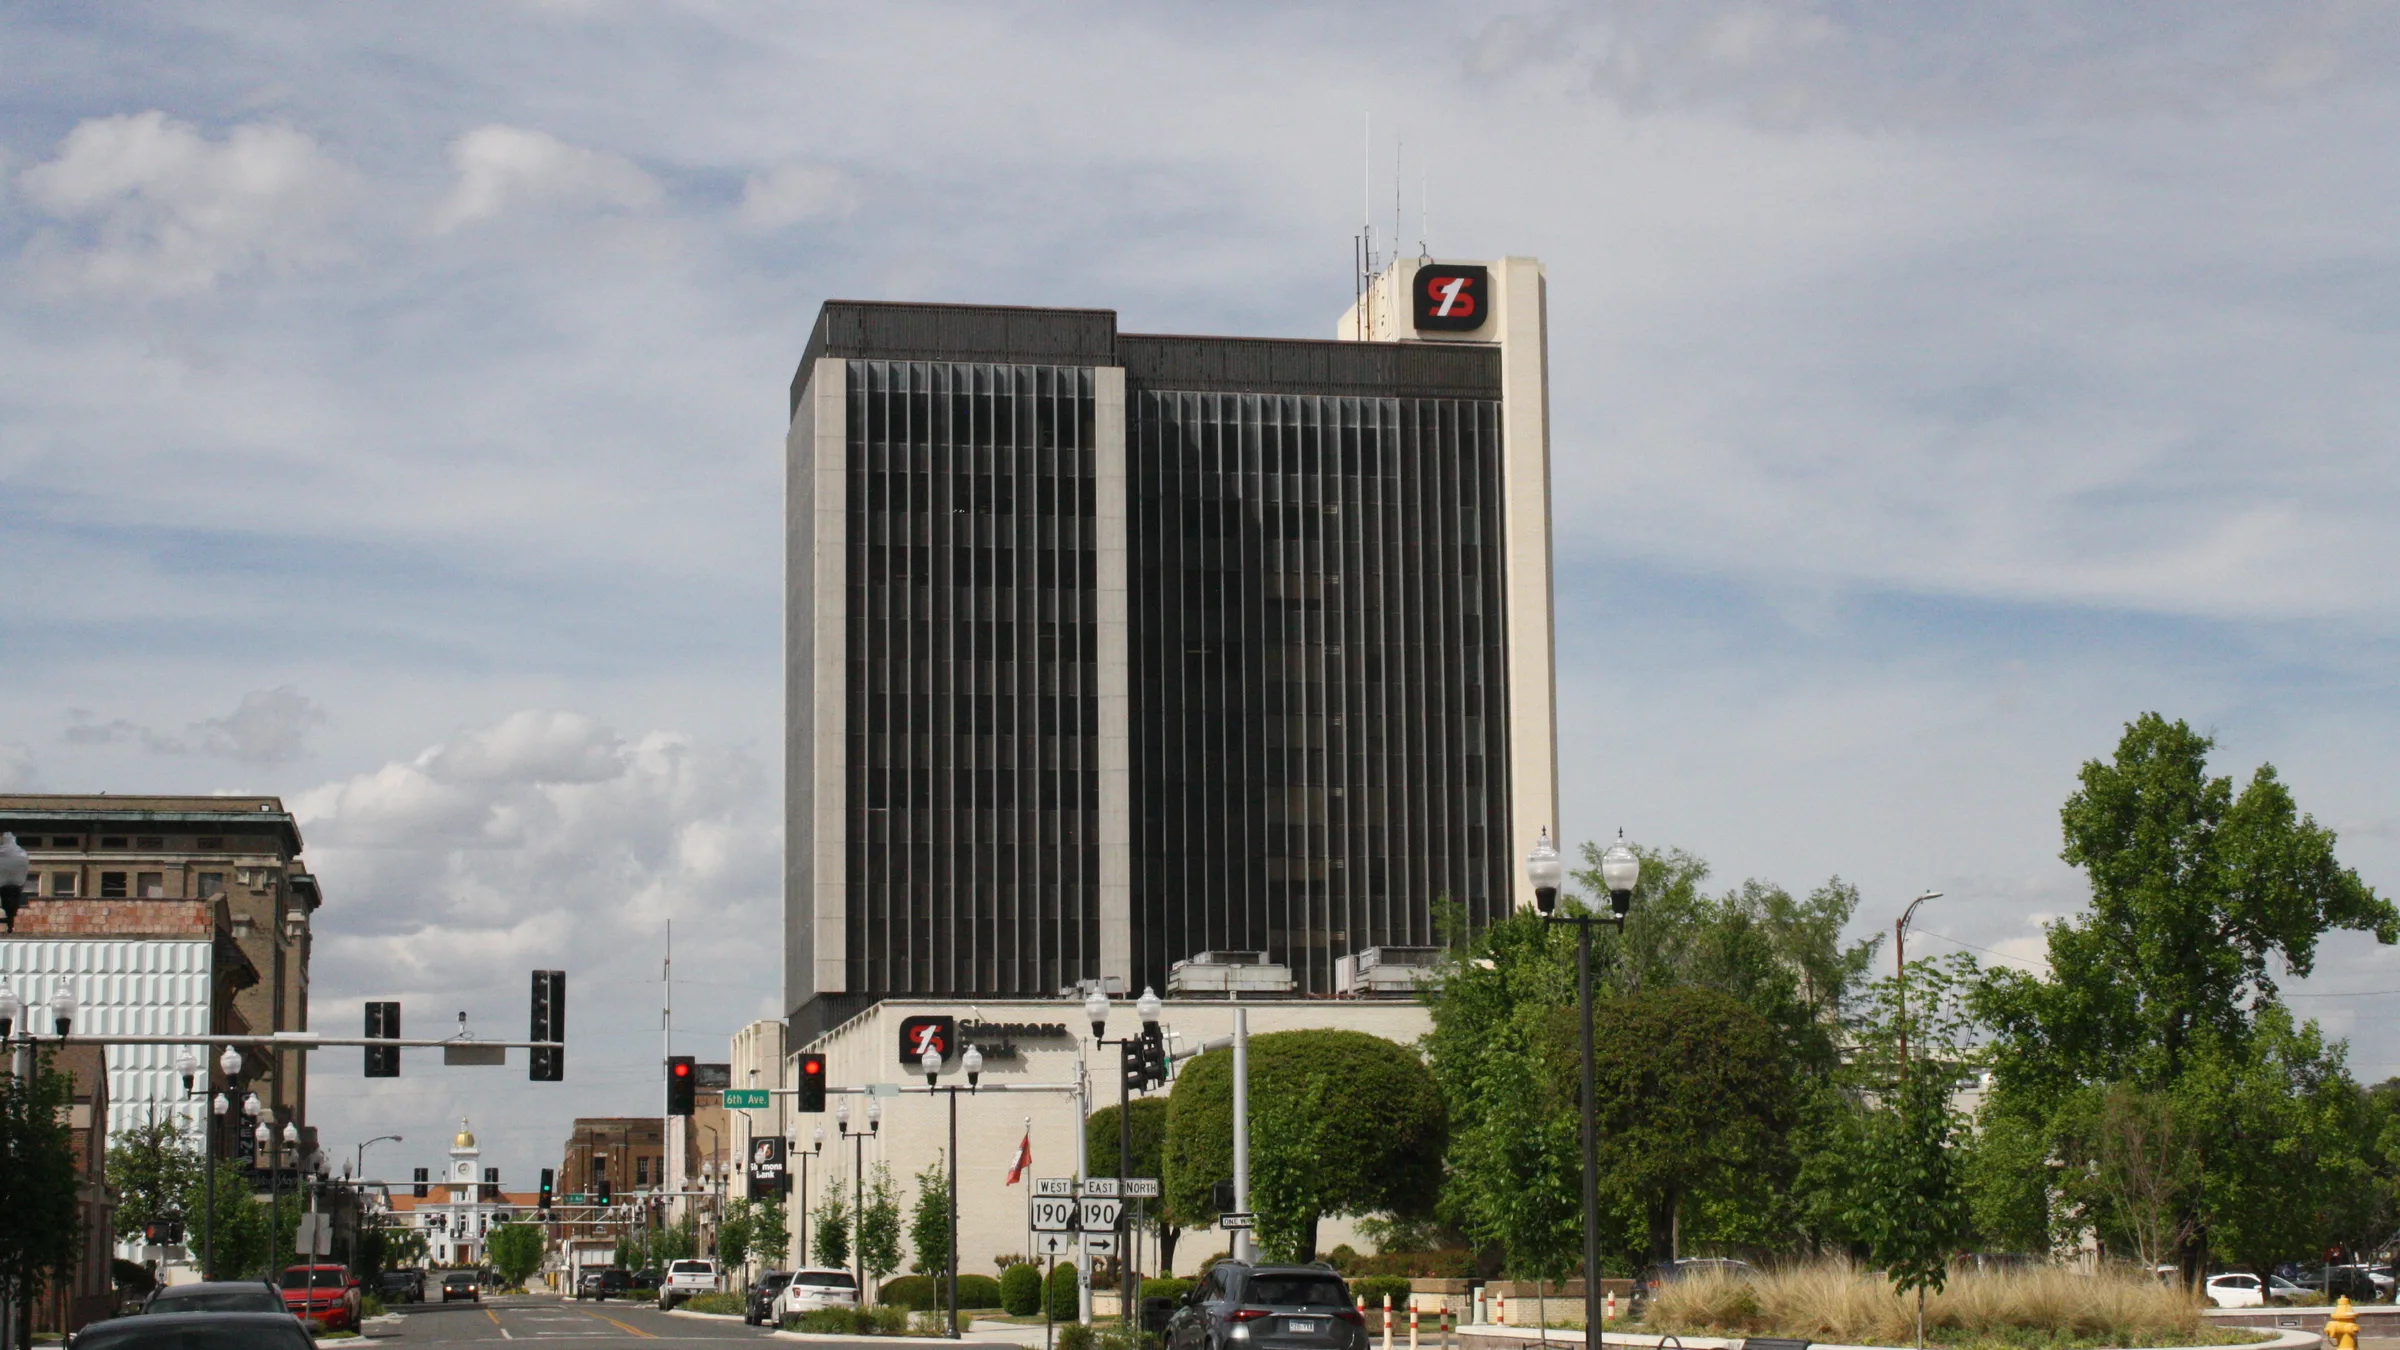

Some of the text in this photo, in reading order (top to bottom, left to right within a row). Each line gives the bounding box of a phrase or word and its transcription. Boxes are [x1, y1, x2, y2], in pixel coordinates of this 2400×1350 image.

[958, 1018, 1067, 1038] Simmons
[726, 1094, 767, 1105] 6th Ave.
[1040, 1181, 1068, 1193] WEST
[1089, 1181, 1113, 1193] EAST
[1126, 1181, 1157, 1194] NORTH
[1036, 1204, 1067, 1223] 190
[1084, 1204, 1114, 1224] 190
